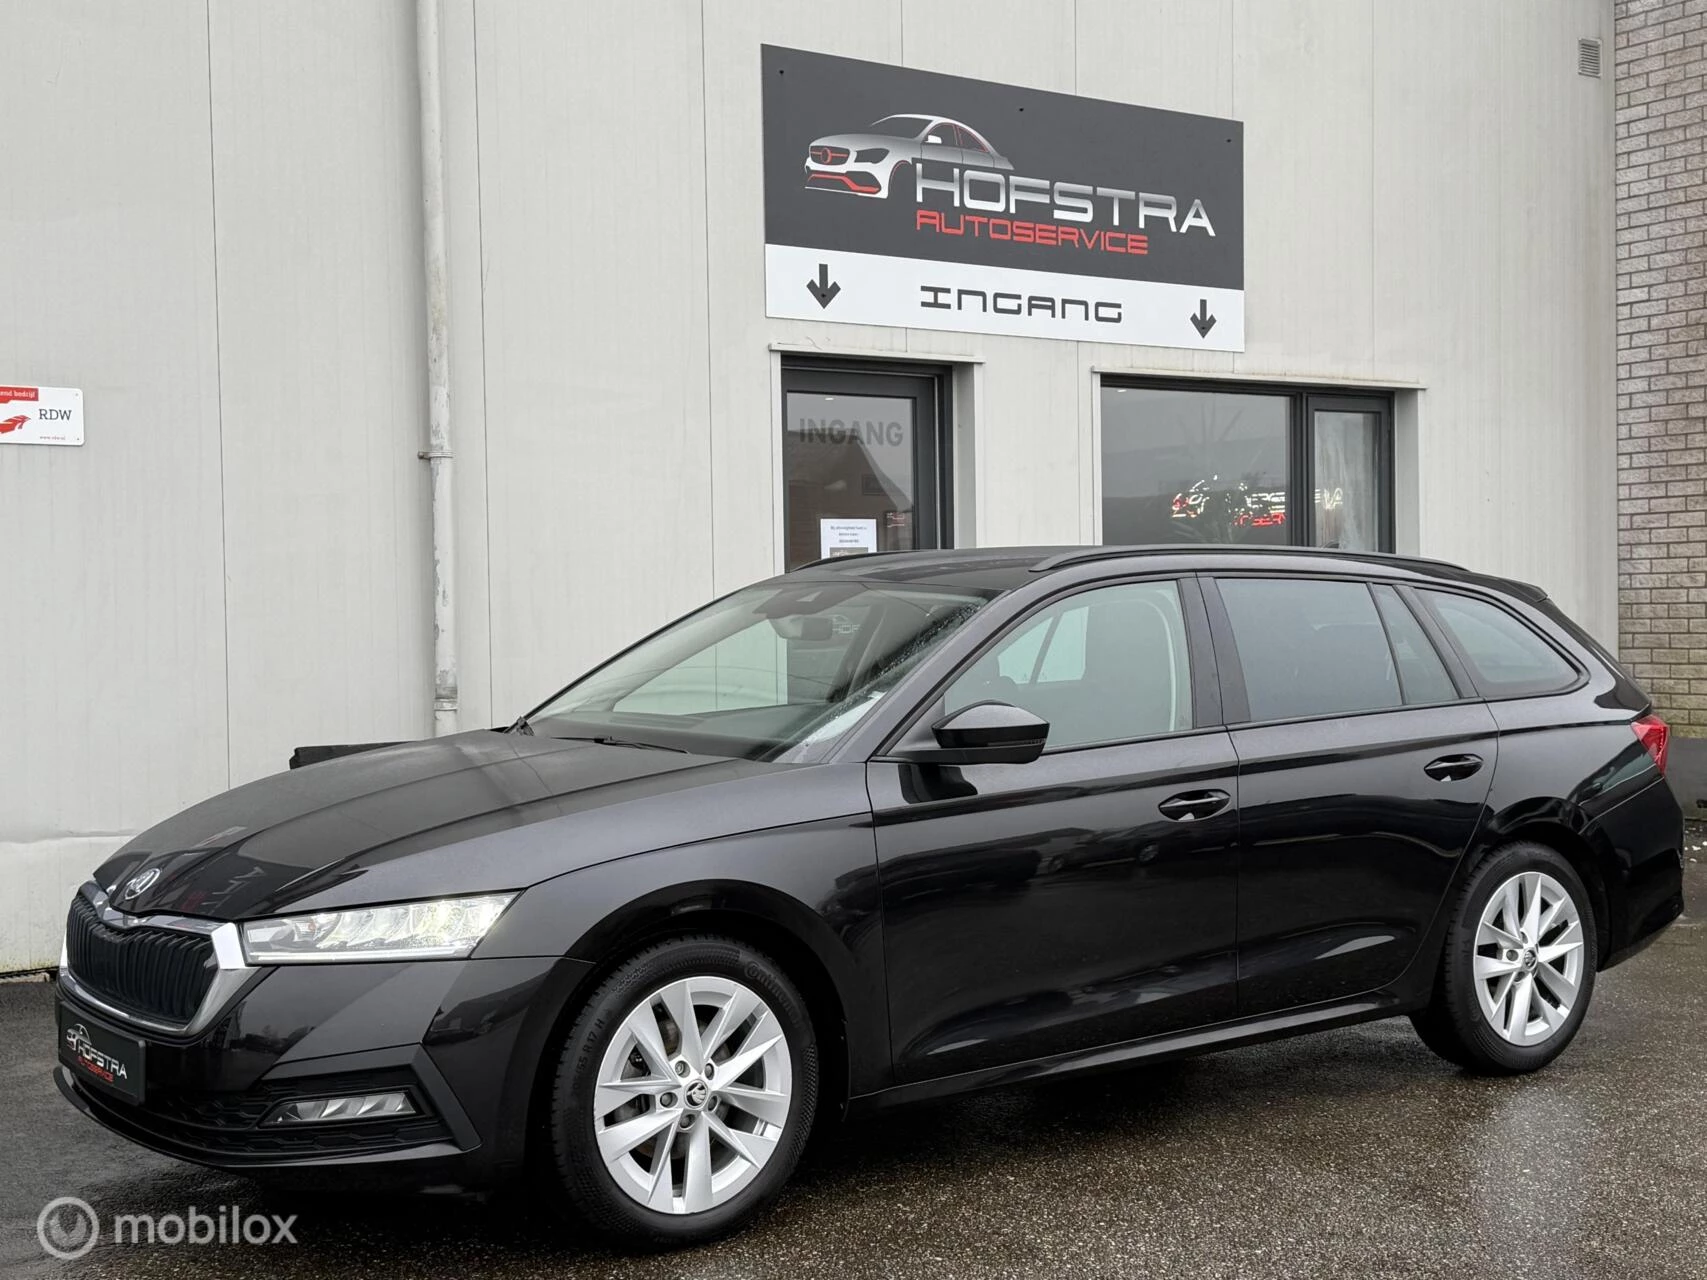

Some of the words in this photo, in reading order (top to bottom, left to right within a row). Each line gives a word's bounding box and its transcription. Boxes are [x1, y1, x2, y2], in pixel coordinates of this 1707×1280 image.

[915, 163, 1216, 237] HOFSTRA
[915, 209, 1149, 255] AUTOSERVICE
[920, 285, 1123, 324] INGANG
[38, 408, 72, 421] RDW
[799, 418, 904, 447] INGANG
[77, 1040, 128, 1080] HOFSTRA
